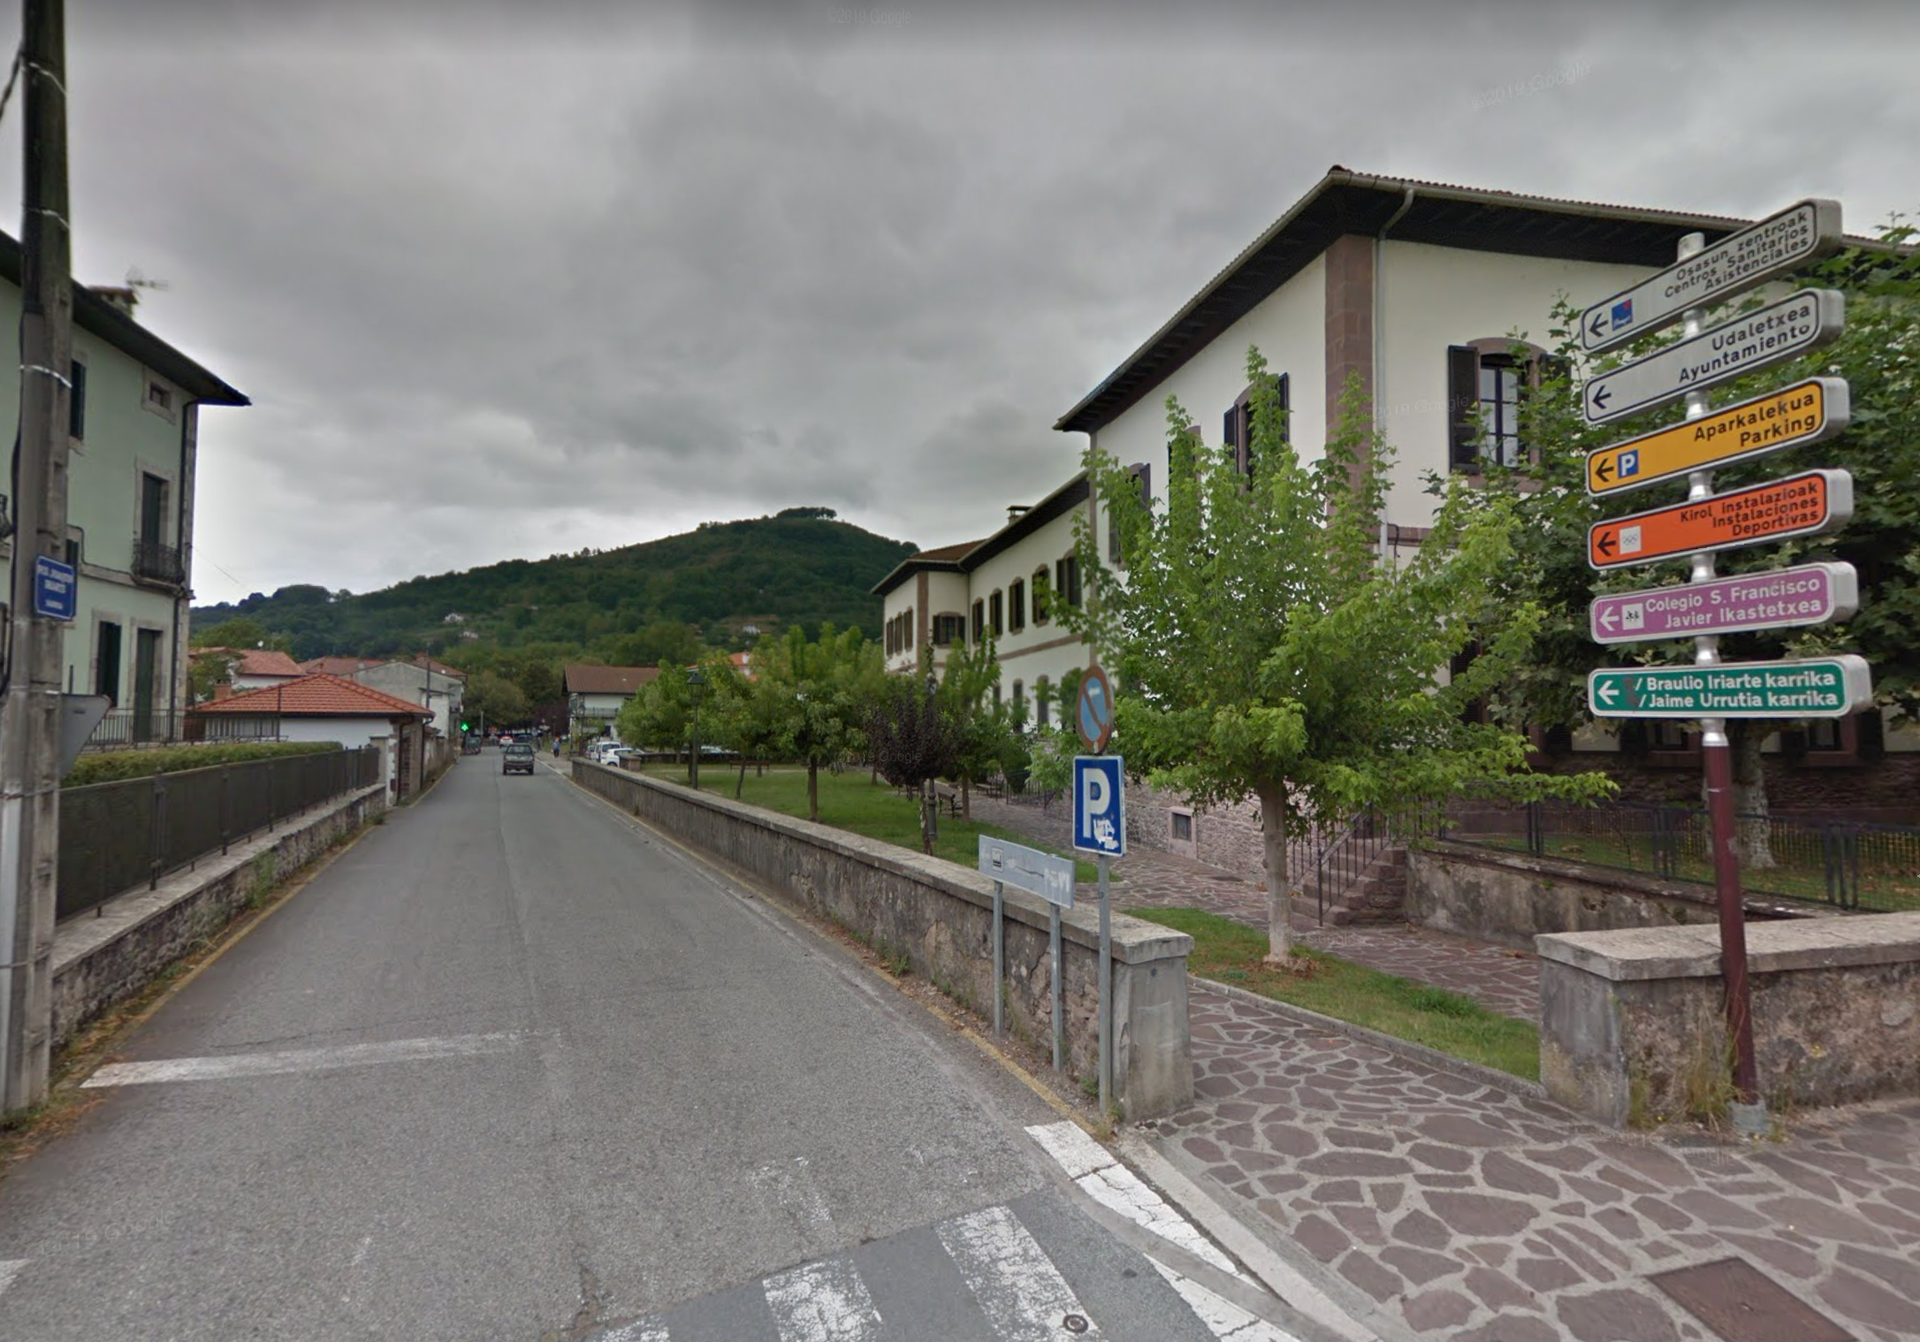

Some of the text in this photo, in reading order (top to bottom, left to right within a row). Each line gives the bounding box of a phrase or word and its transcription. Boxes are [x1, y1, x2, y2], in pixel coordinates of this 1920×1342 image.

[1665, 226, 1808, 298] Centros Sanitarios
[1677, 212, 1807, 281] Osasun zentroak
[1704, 237, 1808, 291] Asistenciales
[1712, 305, 1810, 351] Udaletxea
[1679, 324, 1810, 383] Ayuntamiento
[1694, 394, 1814, 442] Aparkalekua
[1740, 415, 1816, 447] Parking
[1621, 454, 1635, 476] P
[1680, 481, 1818, 523] Kirol instalazioak
[1713, 496, 1819, 528] Instalaciones
[1732, 510, 1819, 537] Deportivas
[1646, 577, 1821, 612] Colegio S. Francisco
[1664, 599, 1822, 628] Javier Ikastetxea
[1647, 675, 1704, 691] Braulio
[1708, 674, 1762, 690] Iriarte
[1766, 671, 1836, 688] karrika
[1700, 692, 1763, 708] Urrutia
[1768, 691, 1839, 707] karrika
[1083, 768, 1111, 839] P
